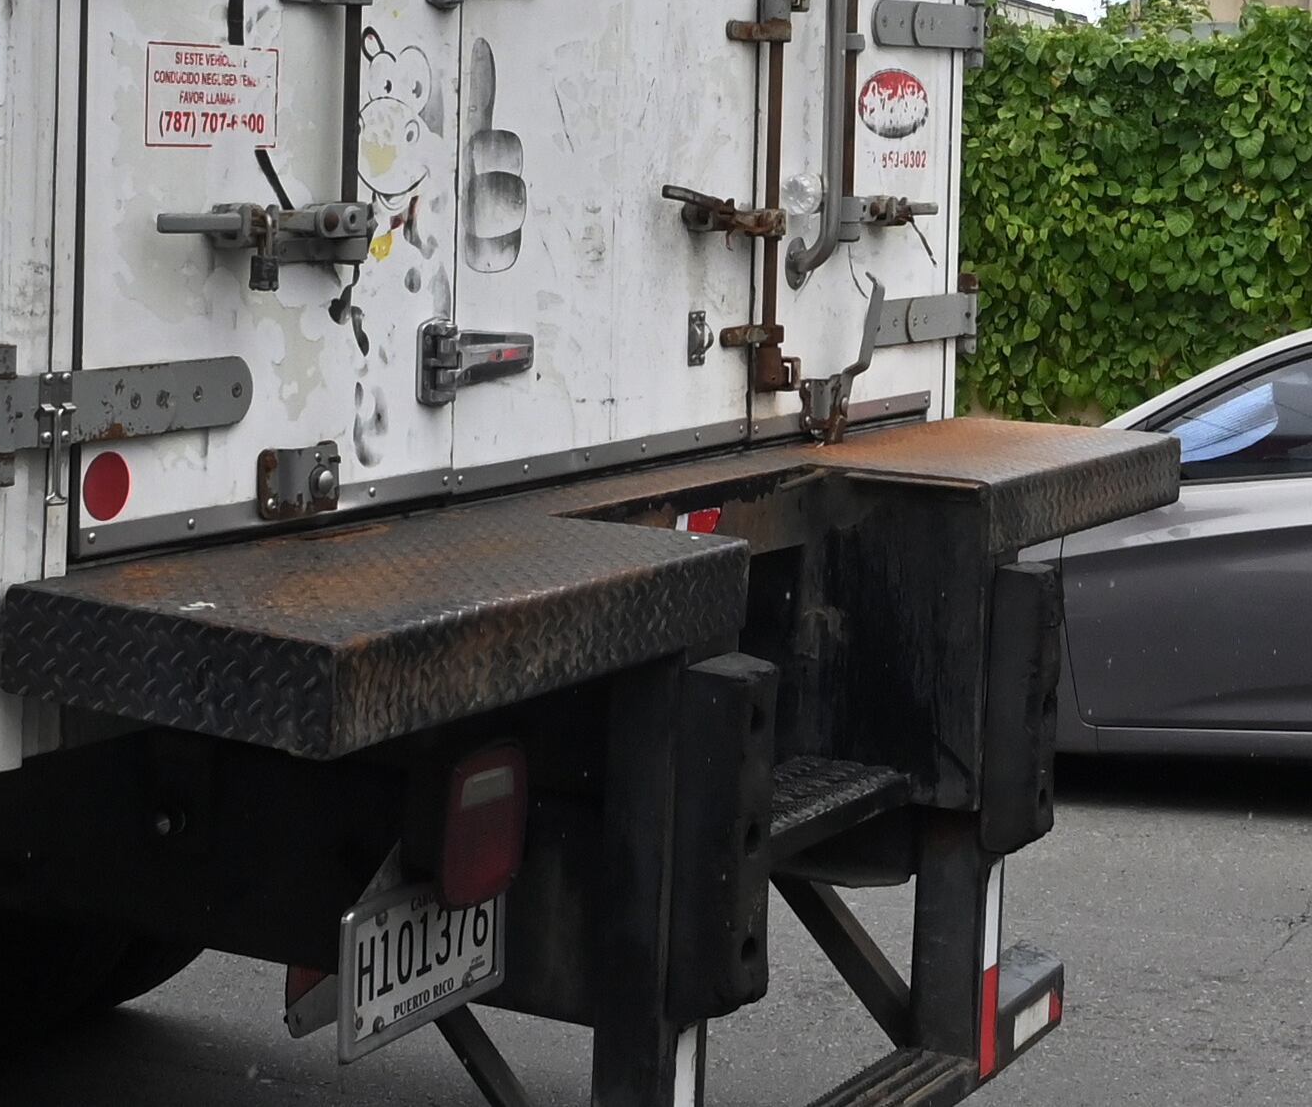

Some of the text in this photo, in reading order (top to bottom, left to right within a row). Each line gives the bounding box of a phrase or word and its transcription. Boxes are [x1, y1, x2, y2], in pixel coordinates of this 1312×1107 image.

[175, 51, 183, 65] SI
[184, 52, 204, 66] ESTE
[153, 71, 200, 85] CONDUCIDO
[179, 91, 204, 104] FAVOR
[159, 110, 197, 138] (787)
[357, 902, 489, 1008] H101376
[393, 977, 455, 1020] PUERTO RICO
